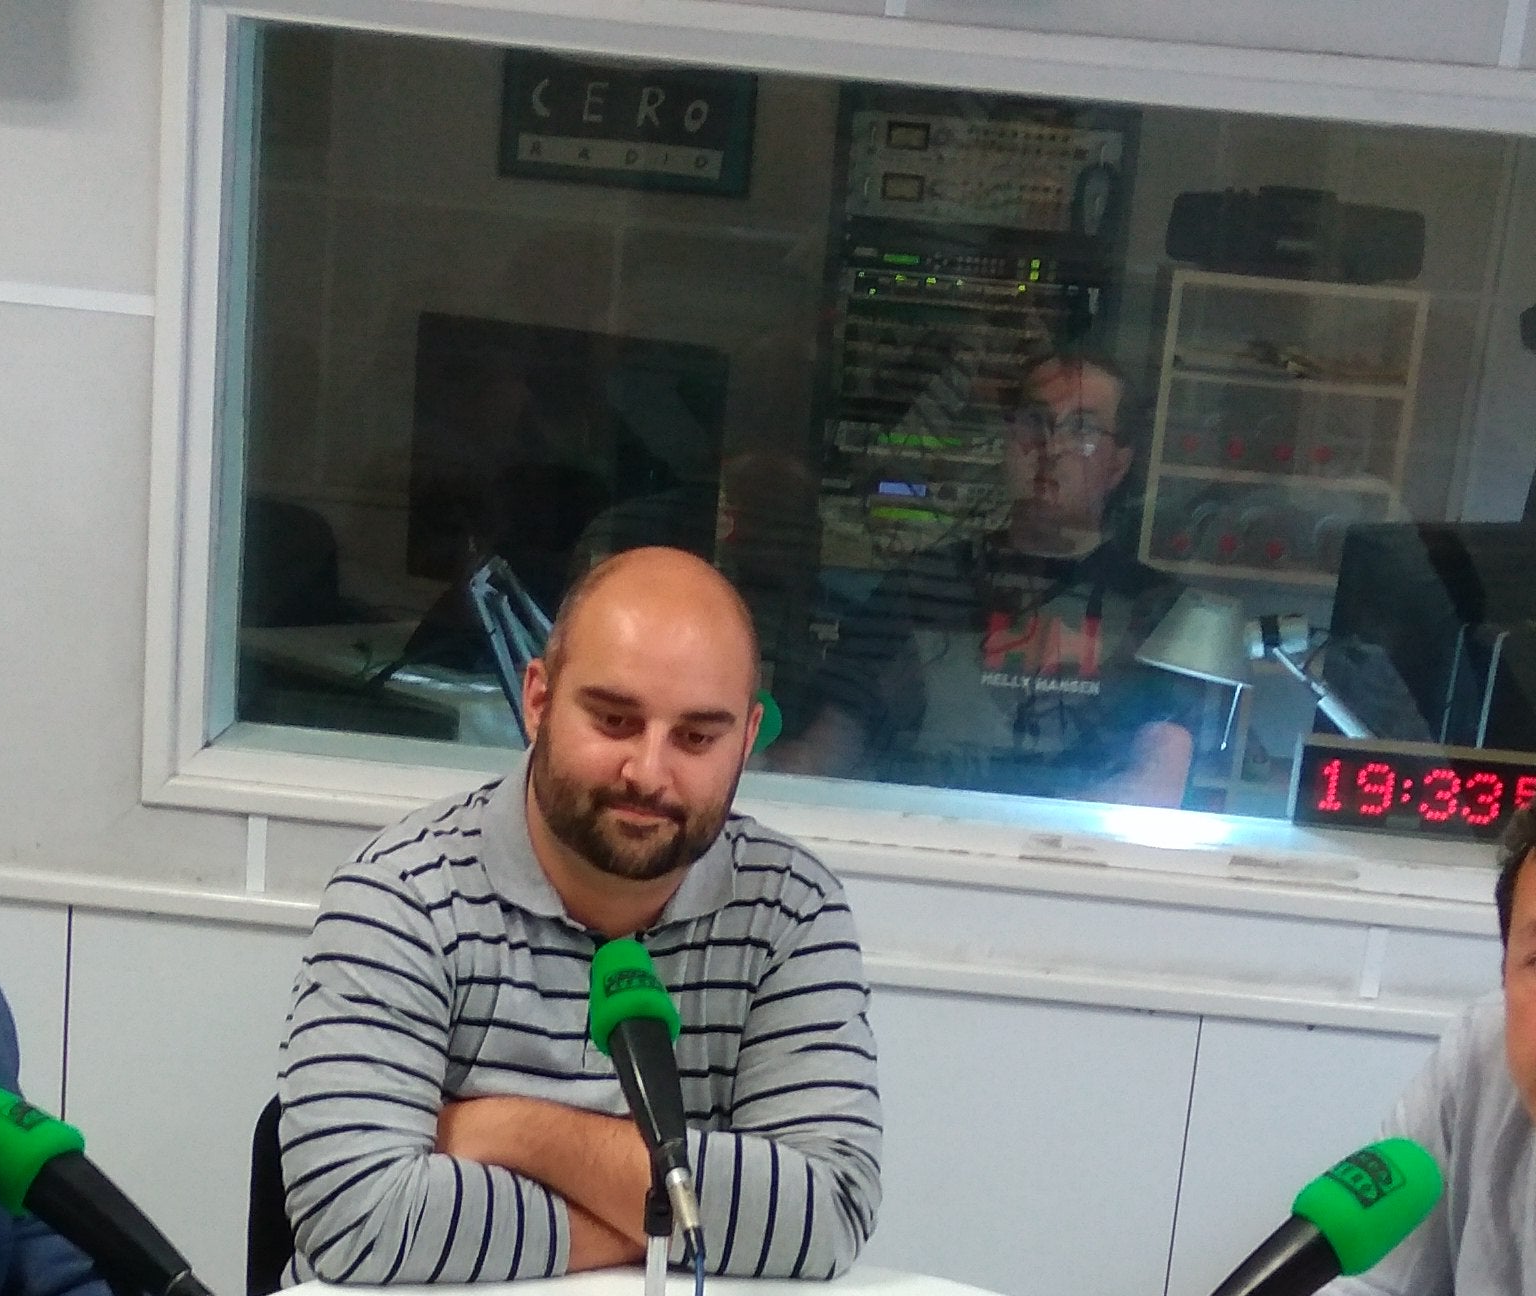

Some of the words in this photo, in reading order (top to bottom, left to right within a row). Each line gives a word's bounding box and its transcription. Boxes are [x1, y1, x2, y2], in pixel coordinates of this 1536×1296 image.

[530, 77, 711, 135] CERO
[529, 141, 709, 168] RADIO
[981, 672, 1032, 693] HELLY
[1034, 676, 1101, 695] HANSEN
